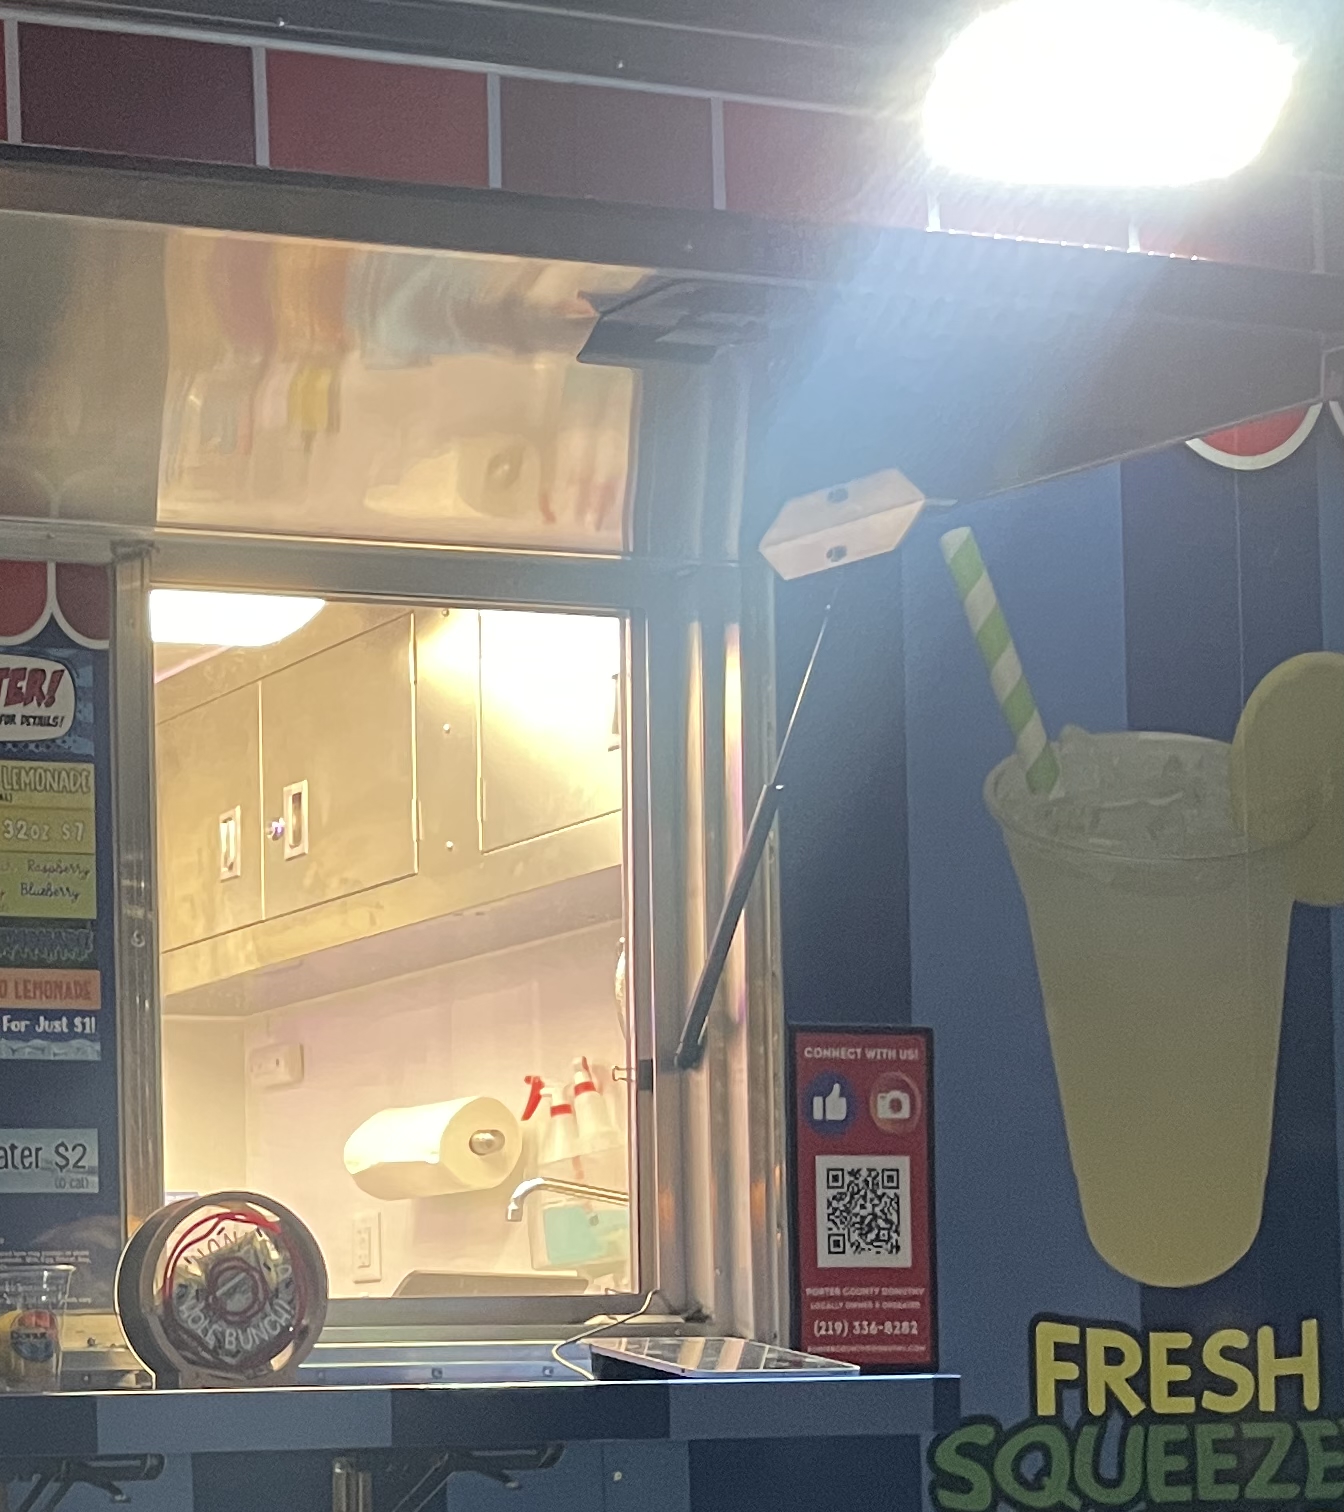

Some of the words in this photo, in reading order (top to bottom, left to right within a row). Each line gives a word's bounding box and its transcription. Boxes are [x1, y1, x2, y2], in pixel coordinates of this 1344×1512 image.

[0, 714, 17, 726] FOR
[2, 766, 91, 794] LEMONADE
[14, 980, 92, 1001] LEMONADE
[2, 1015, 30, 1032] For
[35, 1016, 69, 1033] Just
[804, 1047, 863, 1060] CONNECT
[865, 1047, 897, 1060] WITH
[54, 1141, 88, 1172] $2
[814, 1320, 849, 1338] (219)
[1035, 1317, 1320, 1416] FRESH
[934, 1418, 1344, 1512] SQUEEZE
